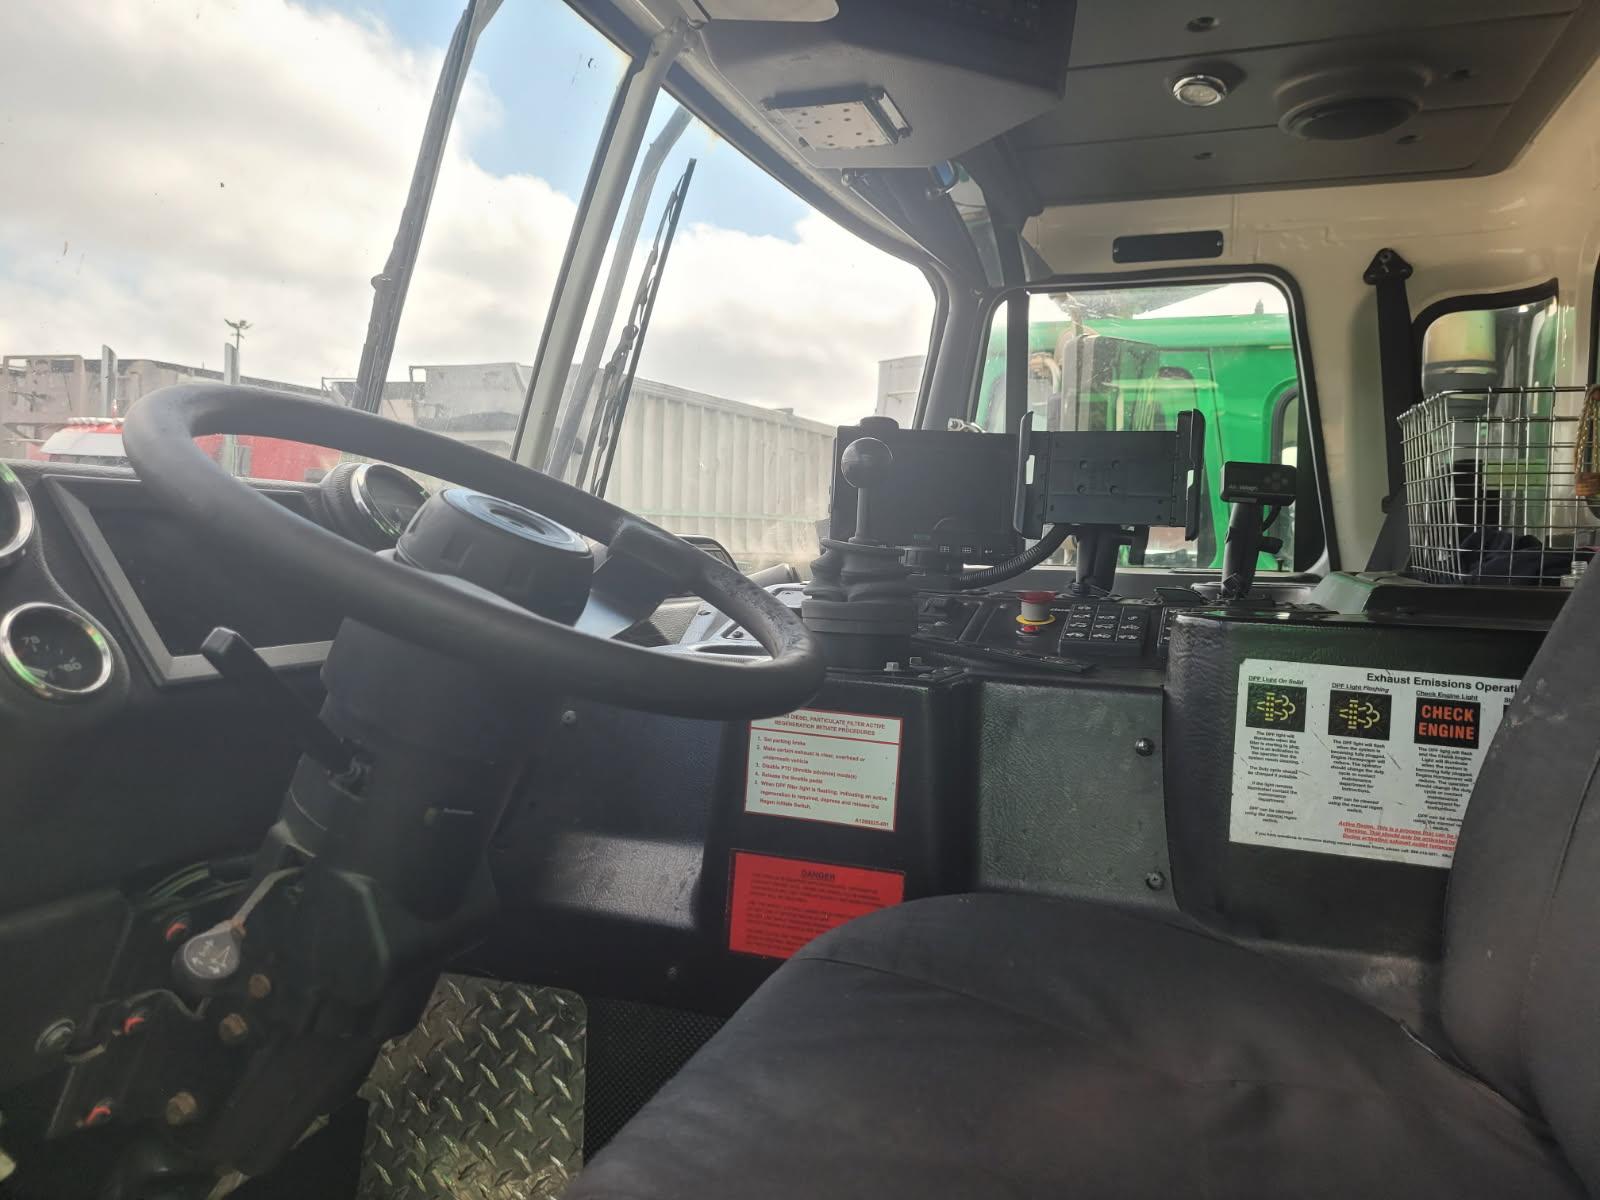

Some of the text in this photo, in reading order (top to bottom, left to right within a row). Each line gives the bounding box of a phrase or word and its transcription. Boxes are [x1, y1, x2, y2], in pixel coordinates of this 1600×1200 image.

[1345, 683, 1361, 691] Light
[1366, 672, 1410, 685] Exhaust
[1413, 676, 1472, 690] Emissions
[1461, 694, 1478, 702] Light
[1421, 704, 1474, 722] CHECK
[1418, 722, 1474, 740] ENGINE
[800, 869, 836, 881] DANGER
